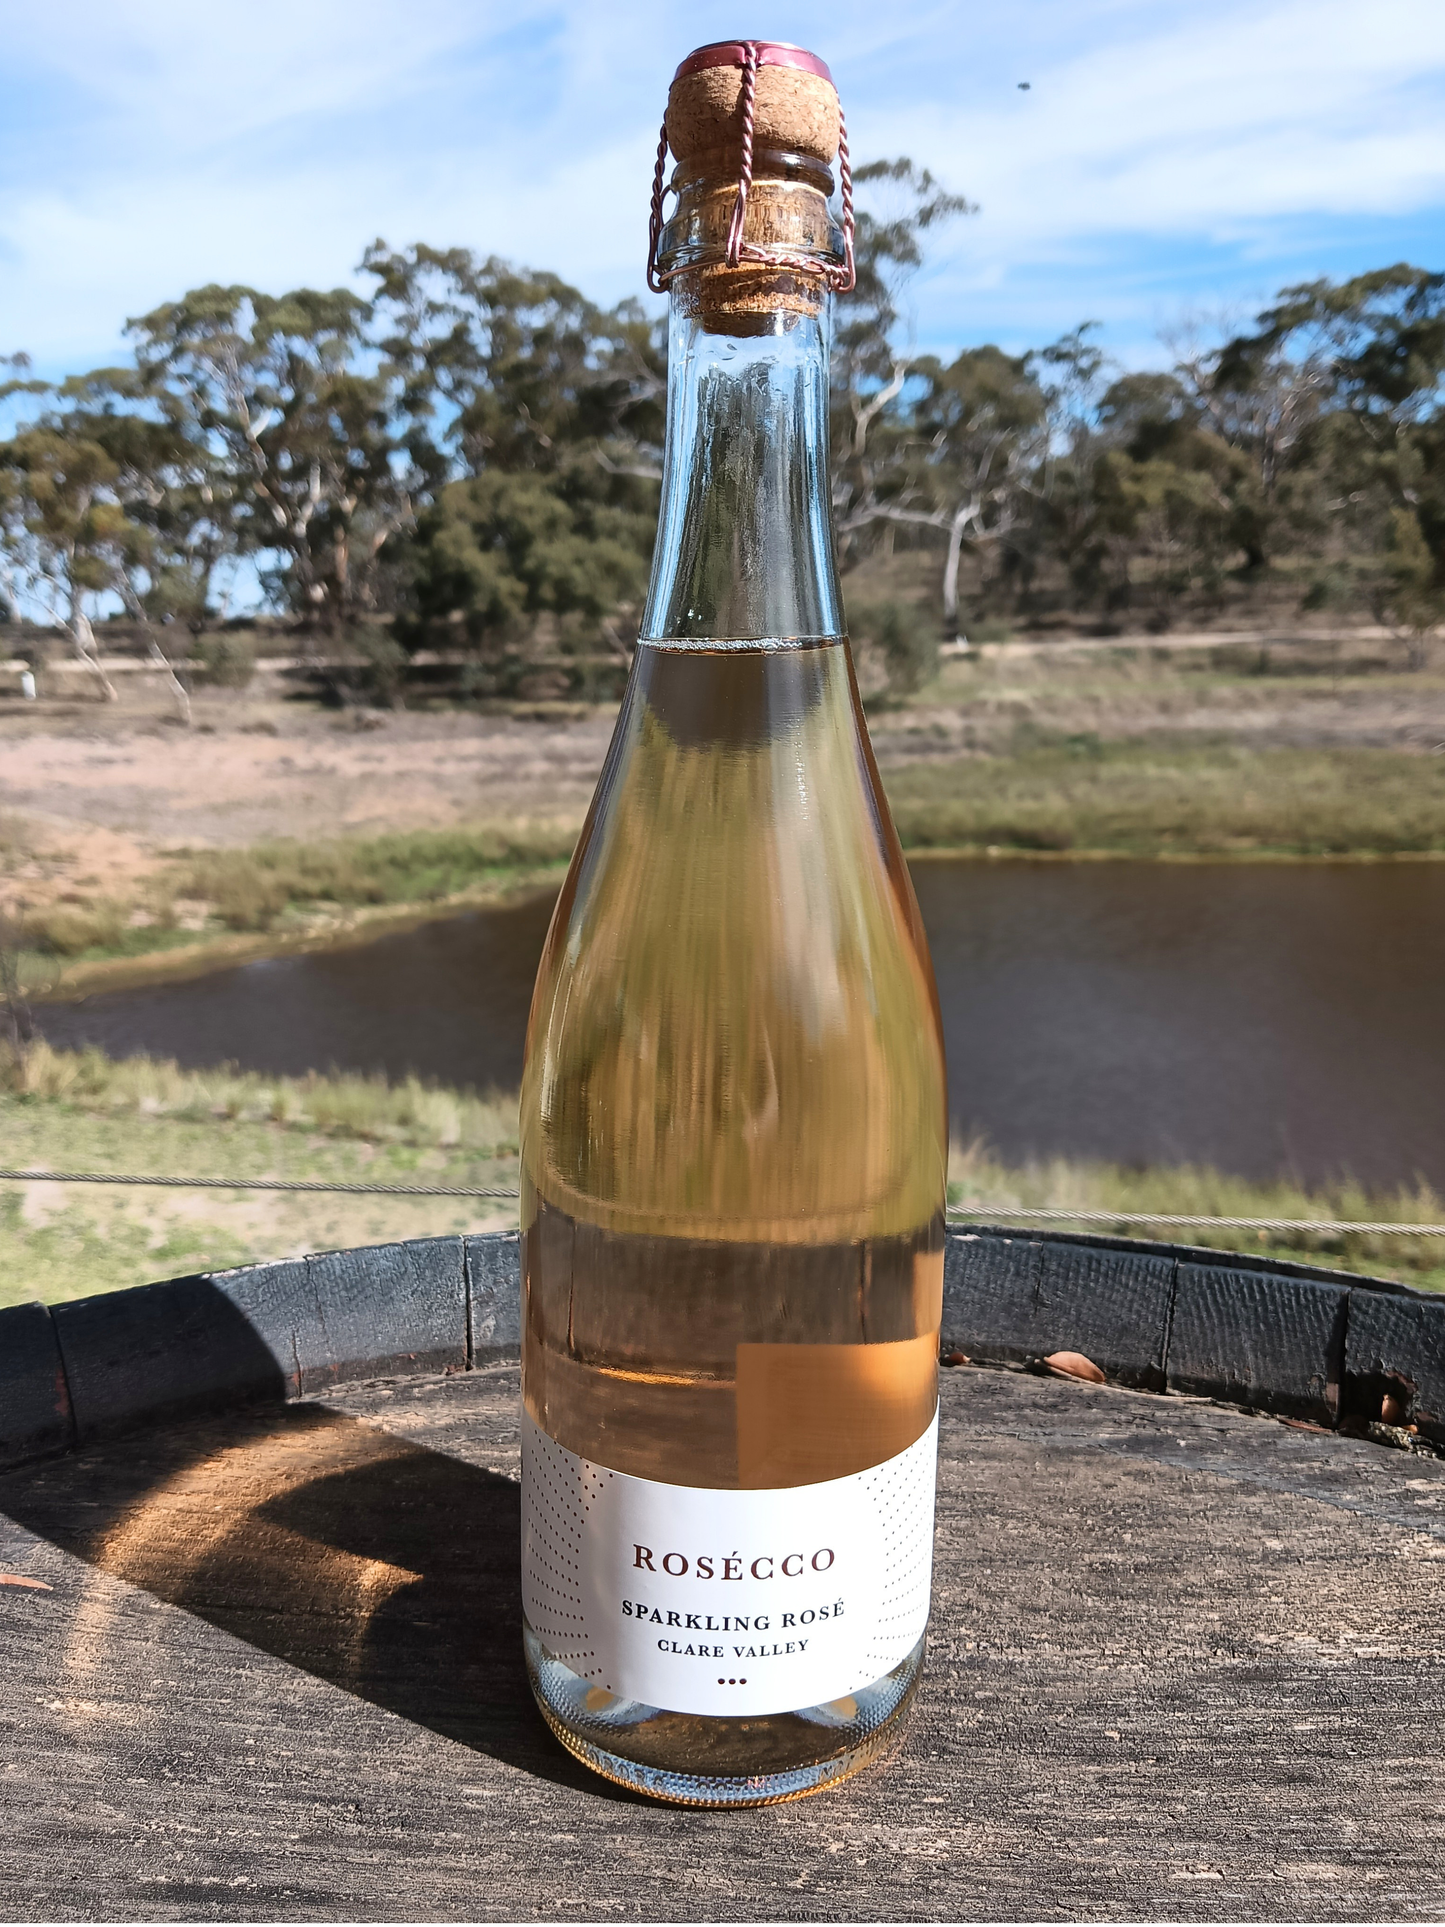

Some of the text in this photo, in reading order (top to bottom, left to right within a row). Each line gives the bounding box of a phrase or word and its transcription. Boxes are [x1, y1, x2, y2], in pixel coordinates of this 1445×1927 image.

[632, 1543, 836, 1581] ROSÉCCO
[621, 1597, 845, 1632] SPARKLING ROSÉ
[657, 1638, 809, 1659] CLARE VALLEY
